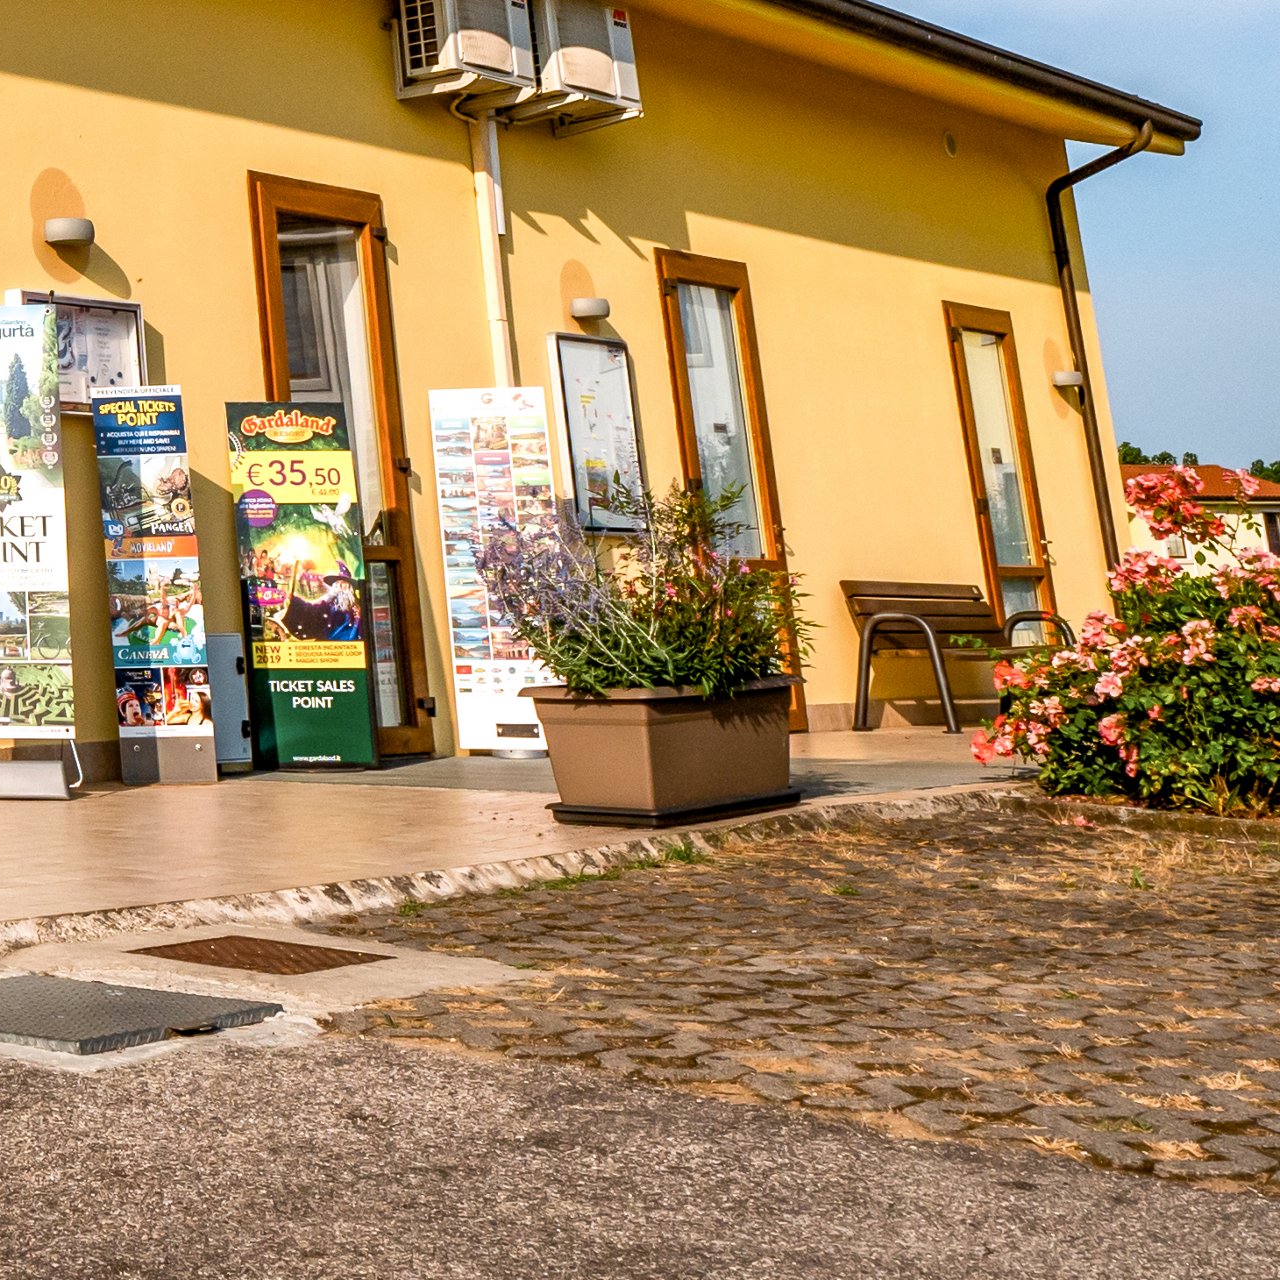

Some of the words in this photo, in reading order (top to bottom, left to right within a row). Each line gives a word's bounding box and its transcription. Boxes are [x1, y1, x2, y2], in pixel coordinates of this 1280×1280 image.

[98, 400, 138, 415] SPECIAL
[138, 400, 177, 413] TICKETS
[116, 412, 159, 427] POINT
[241, 409, 337, 437] Gardaland
[246, 463, 265, 487] €
[268, 460, 341, 489] 35,50
[150, 521, 194, 535] PANGEA
[130, 541, 173, 553] MOVIELAND
[255, 645, 281, 654] NEW
[256, 654, 281, 664] 2019
[268, 680, 314, 692] TICKET
[316, 680, 356, 692] SALES
[292, 696, 333, 709] POINT
